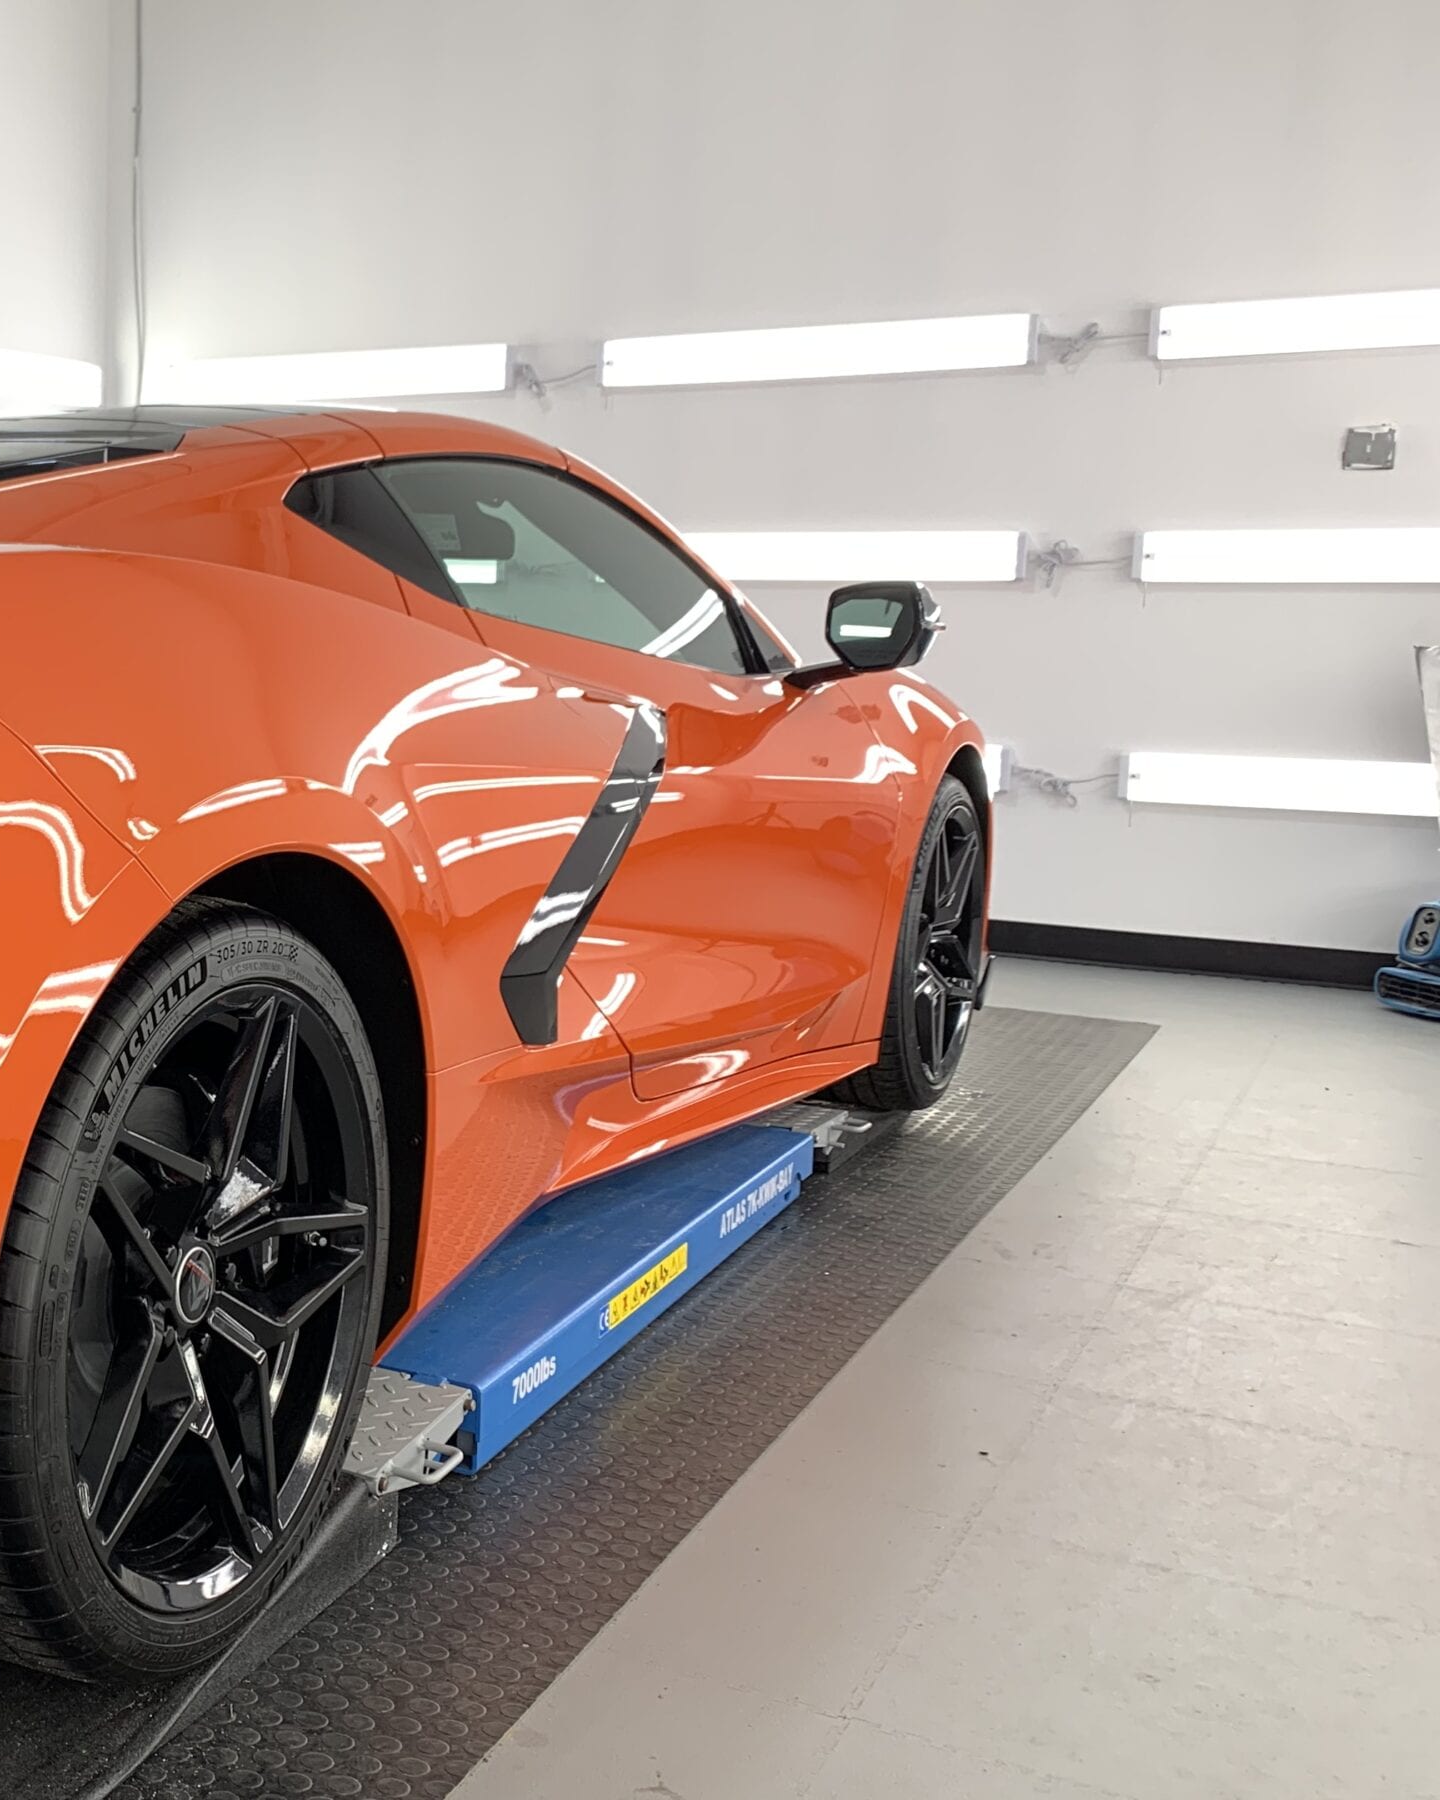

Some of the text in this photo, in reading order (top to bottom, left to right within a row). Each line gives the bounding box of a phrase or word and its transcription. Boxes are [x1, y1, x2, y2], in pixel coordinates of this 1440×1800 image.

[216, 940, 254, 964] 305/30
[103, 960, 203, 1106] MICHELIN
[720, 1198, 746, 1239] ATLAS
[512, 1355, 556, 1405] 7000lbs
